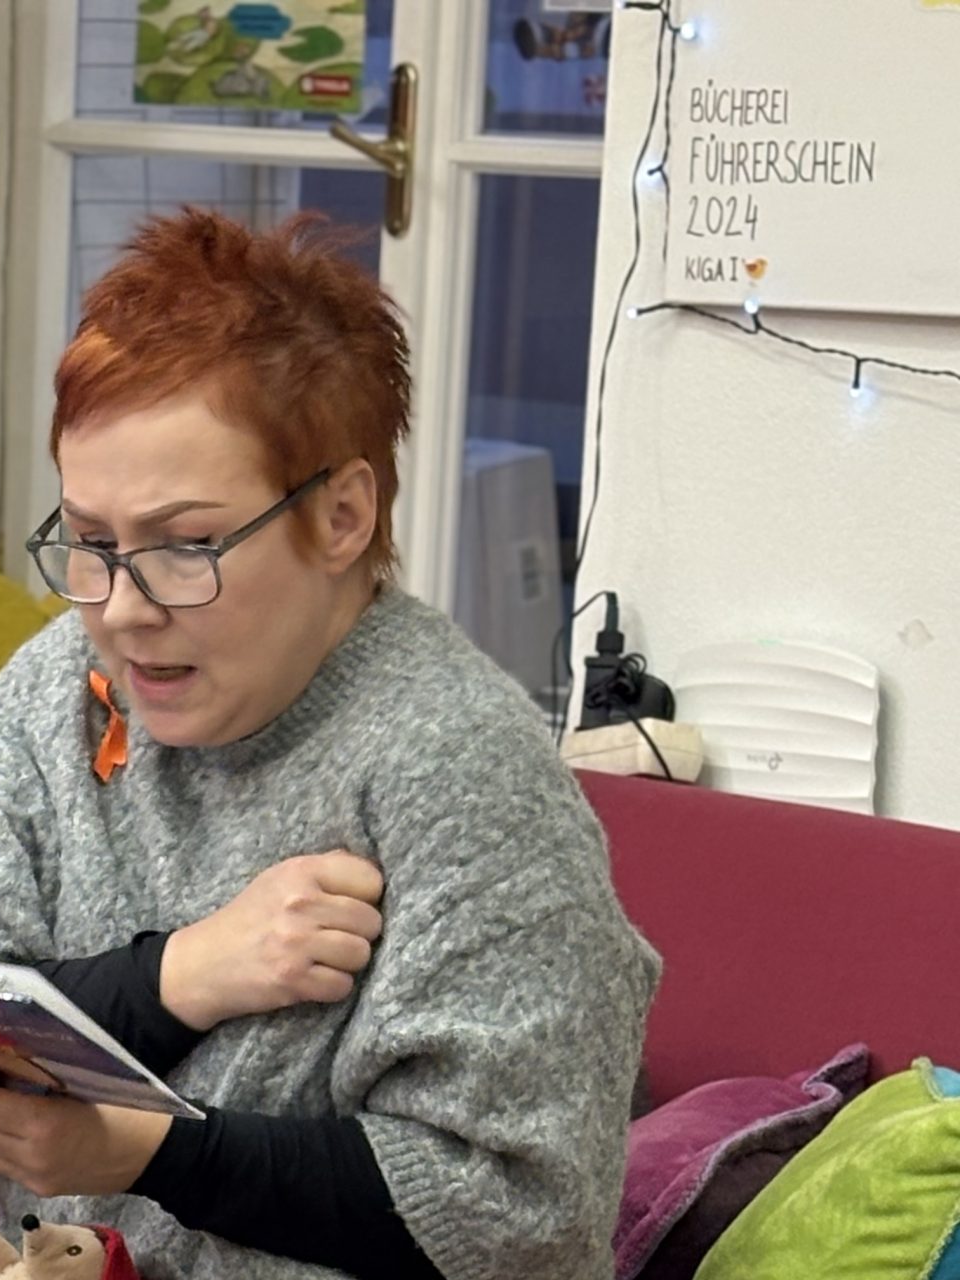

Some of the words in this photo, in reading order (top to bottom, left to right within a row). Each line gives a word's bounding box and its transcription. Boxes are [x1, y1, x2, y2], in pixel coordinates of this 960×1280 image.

[690, 79, 788, 126] BÜCHEREI
[689, 134, 875, 185] FÜHRERSCHEIN
[686, 194, 758, 240] 2024
[685, 257, 724, 283] KIGA
